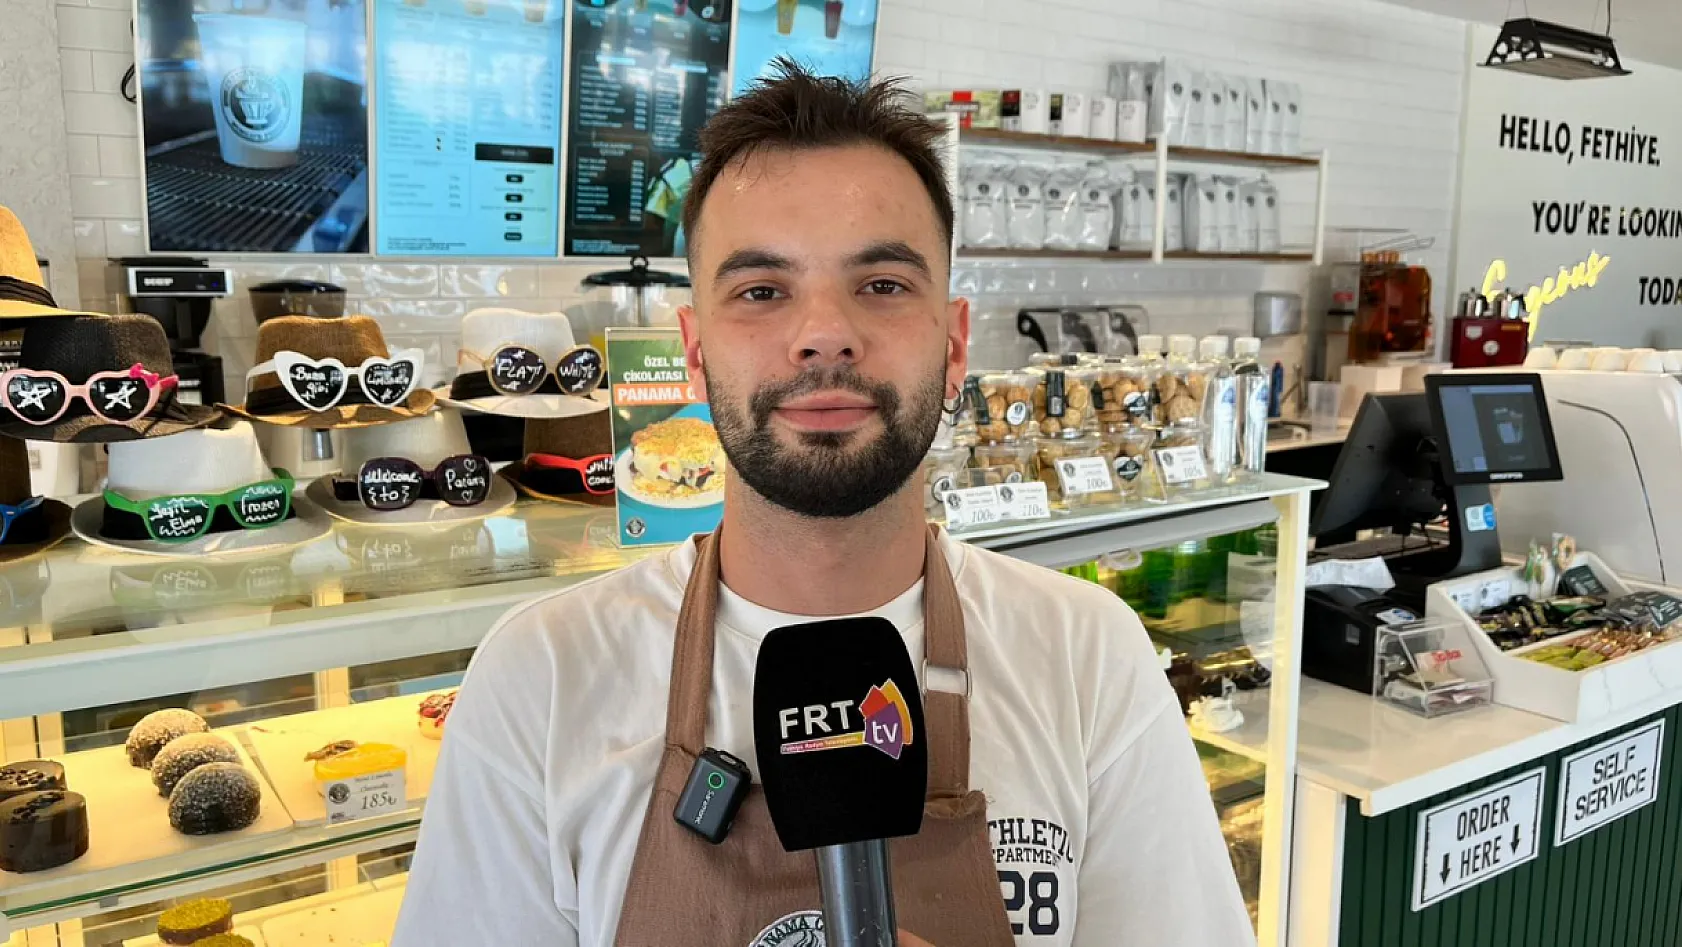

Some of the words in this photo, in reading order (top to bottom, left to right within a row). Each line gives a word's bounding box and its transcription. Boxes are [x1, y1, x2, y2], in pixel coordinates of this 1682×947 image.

[1499, 113, 1574, 166] HELLO,
[672, 356, 687, 367] BE
[617, 387, 682, 402] PANAMA
[779, 700, 854, 739] FRT
[872, 721, 899, 744] tv
[1592, 745, 1636, 785] SELF
[1574, 768, 1647, 821] SERVICE
[1457, 795, 1511, 841] ORDER
[1460, 836, 1502, 879] HERE
[996, 870, 1060, 935] 28
